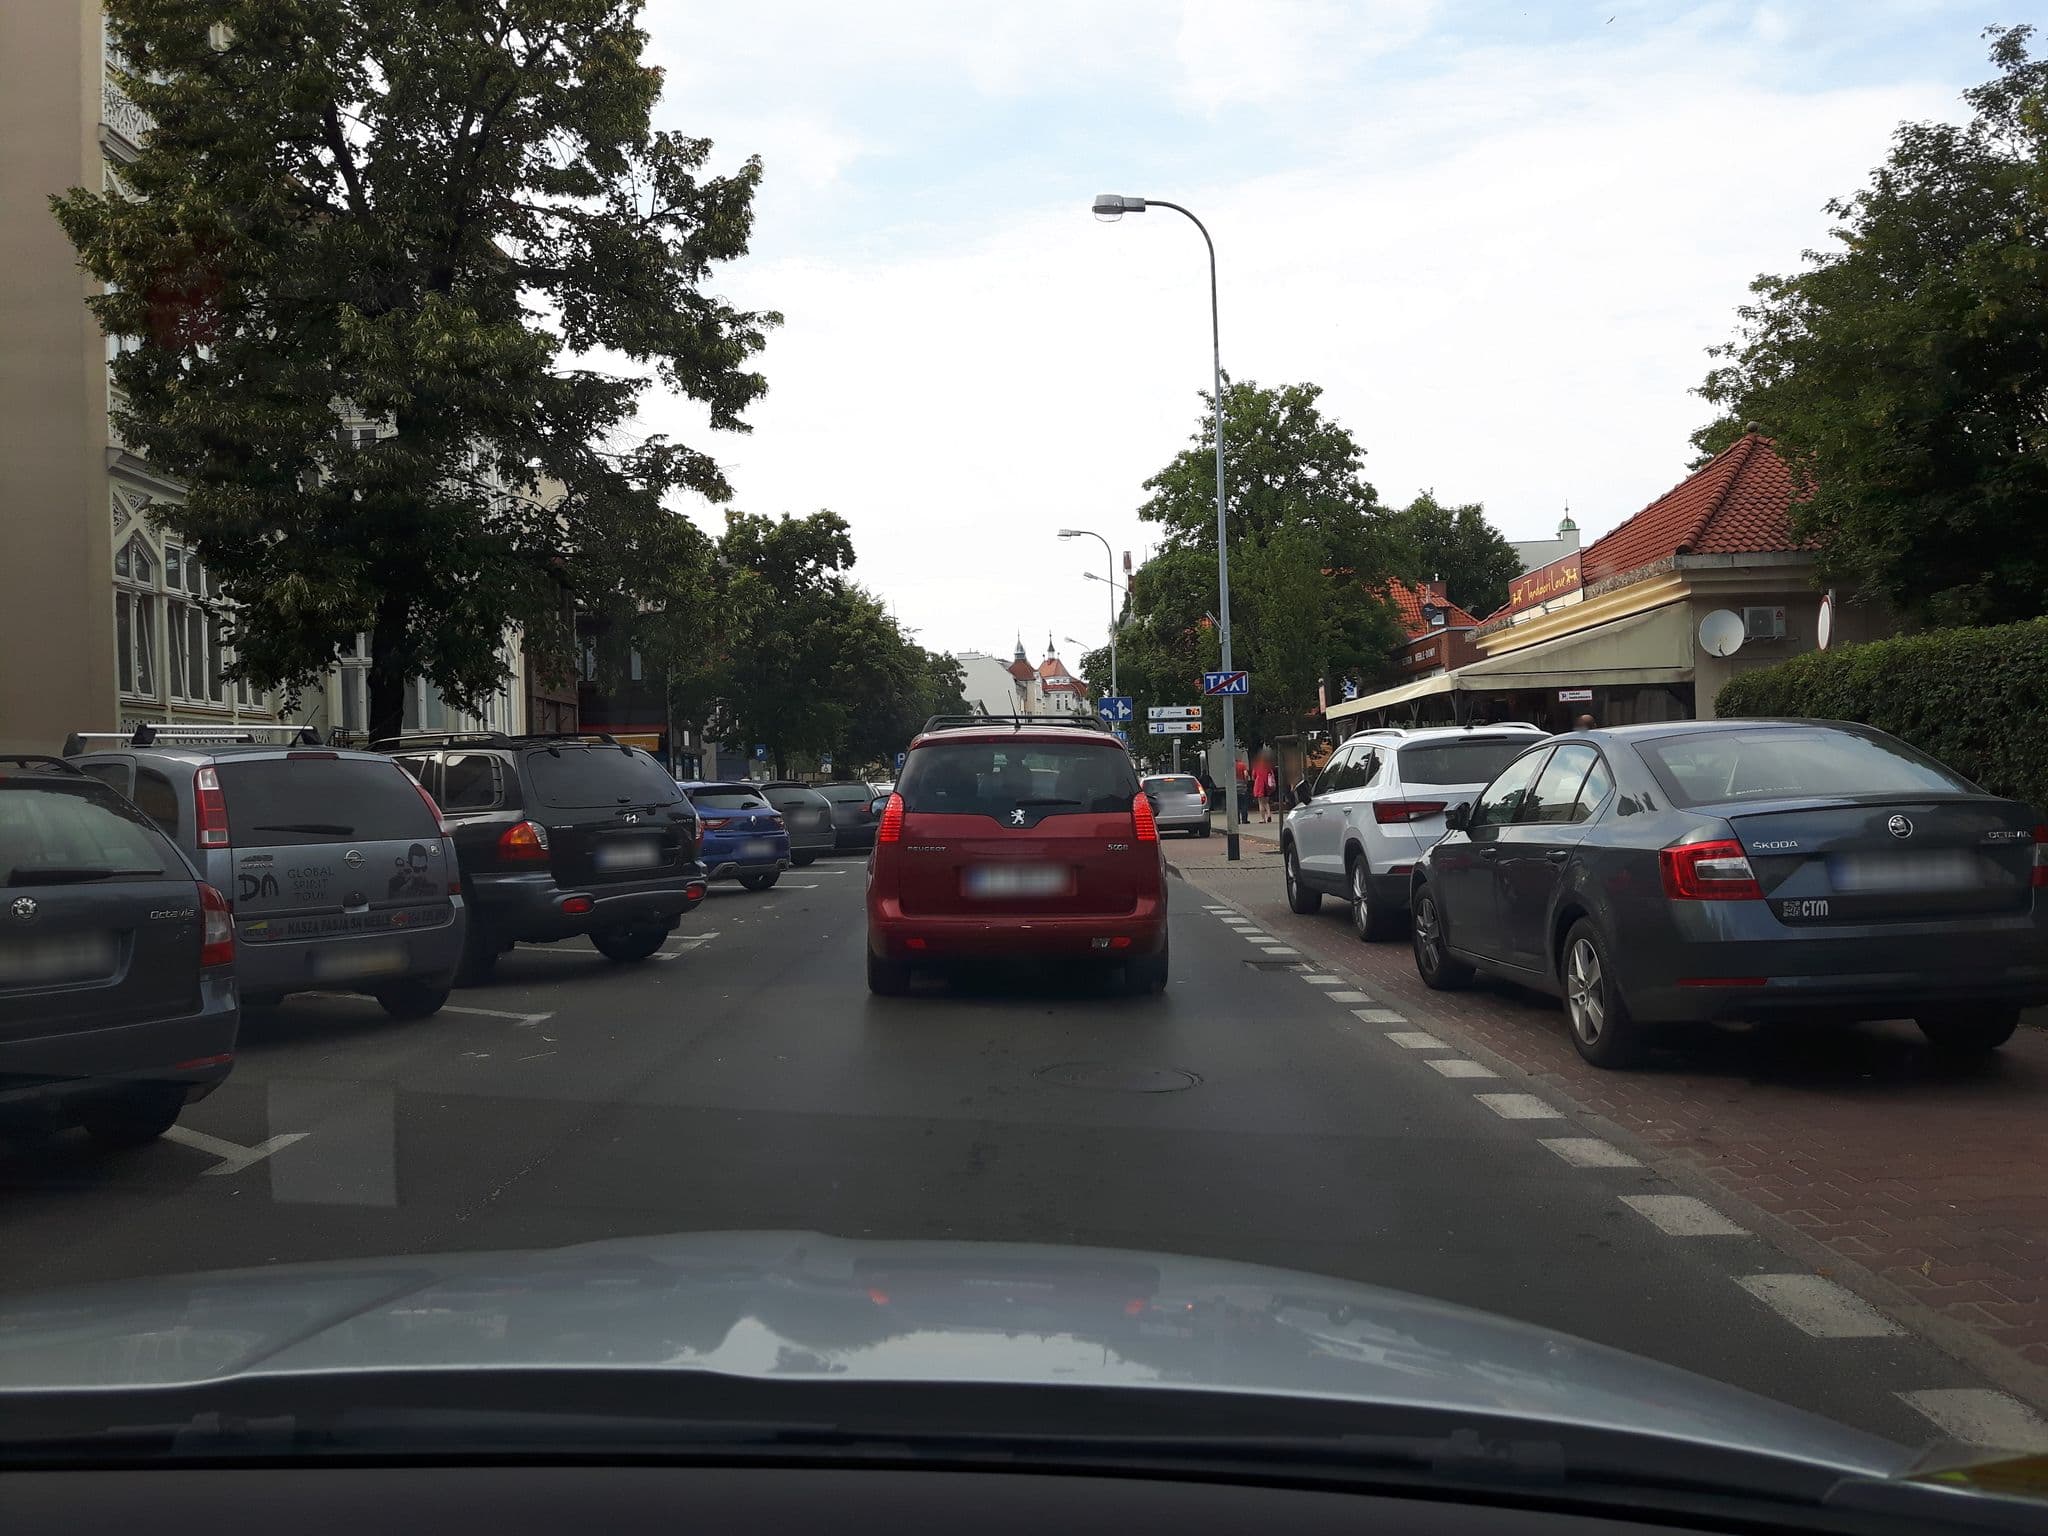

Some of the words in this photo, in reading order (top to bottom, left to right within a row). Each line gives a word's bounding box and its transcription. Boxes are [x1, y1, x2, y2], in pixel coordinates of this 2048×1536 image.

[1524, 577, 1551, 601] Tandoori
[1206, 675, 1247, 692] TAXI
[757, 748, 764, 757] P
[897, 752, 906, 765] P
[907, 845, 947, 853] PEUGEOT
[1752, 839, 1798, 850] ŠKODA
[287, 866, 335, 879] GLOBAL
[294, 879, 328, 891] SPIRIT
[150, 908, 195, 921] Octavia
[1801, 900, 1829, 917] CTM
